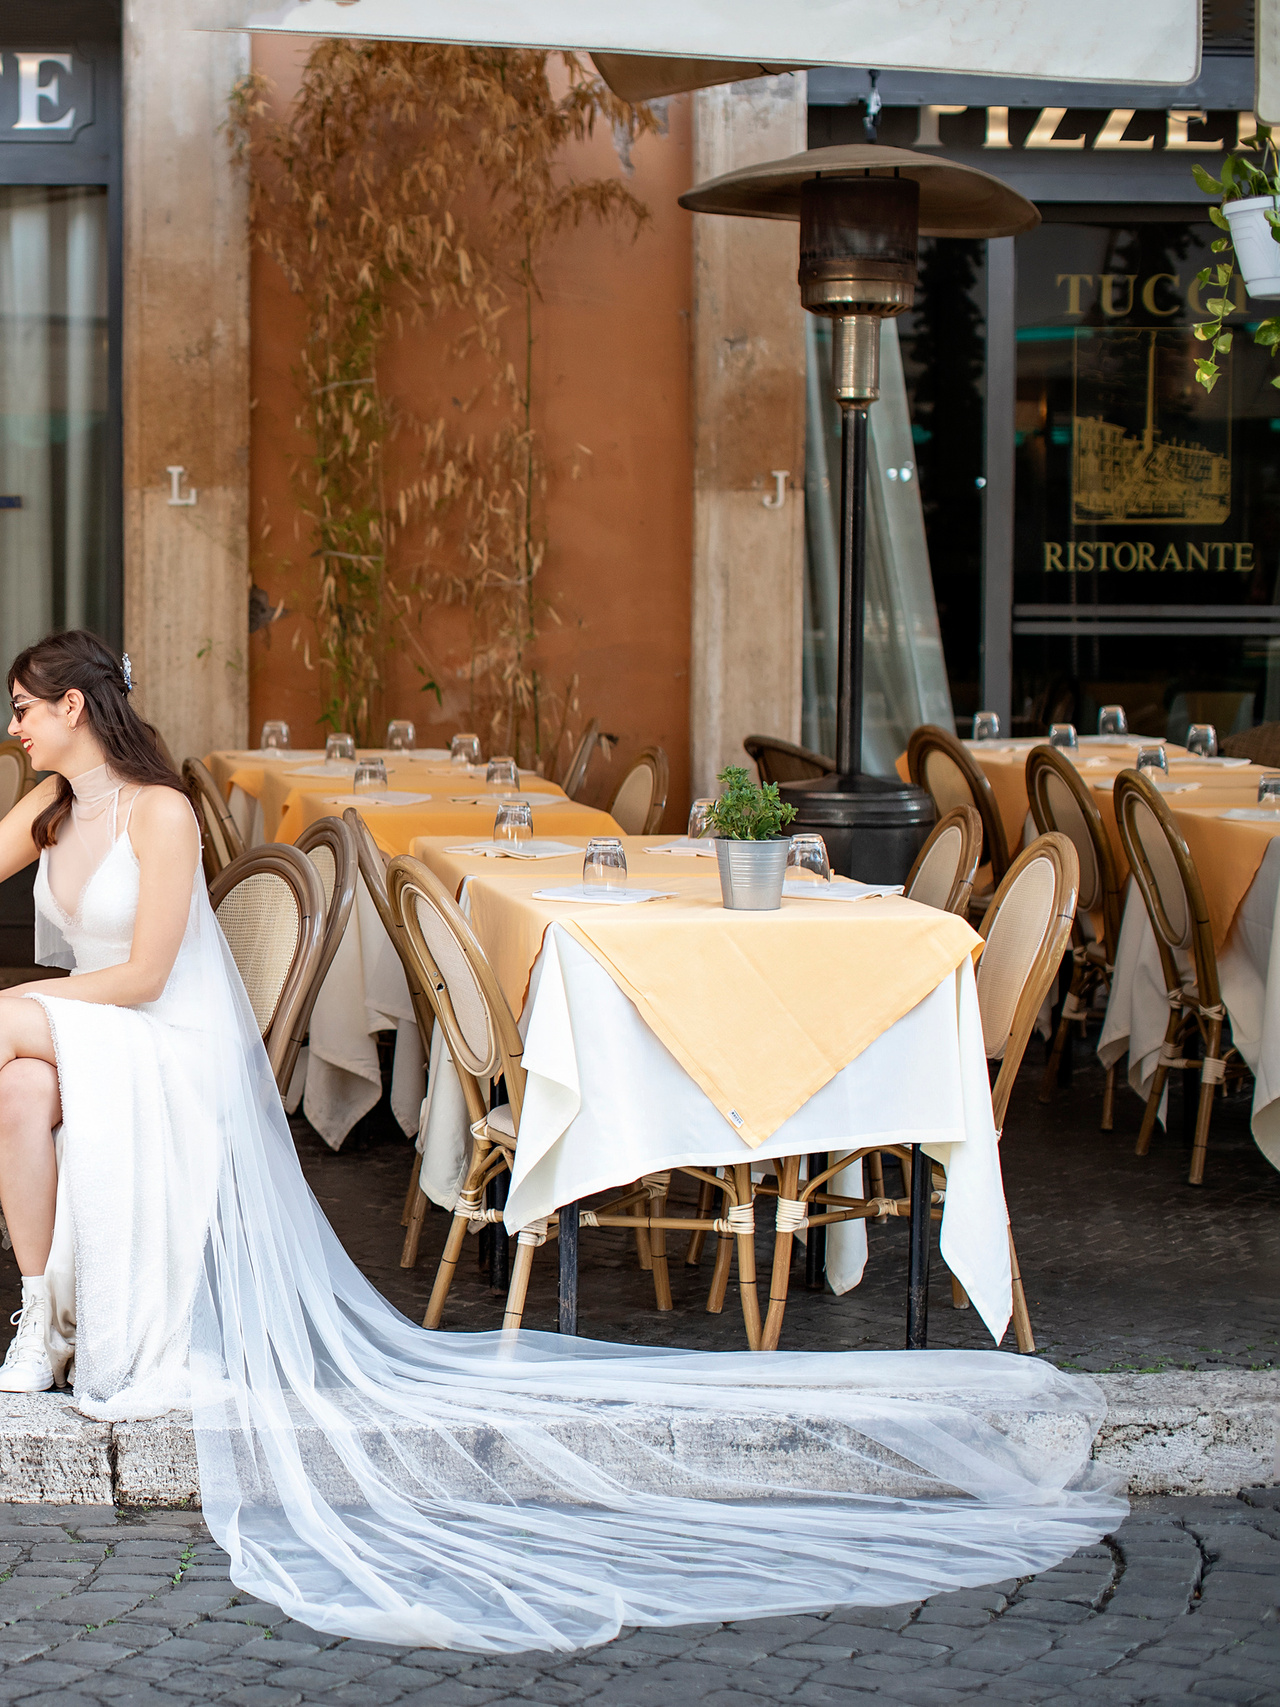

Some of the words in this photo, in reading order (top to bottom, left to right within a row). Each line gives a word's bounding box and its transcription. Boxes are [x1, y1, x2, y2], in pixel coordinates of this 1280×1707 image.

[913, 104, 1280, 150] PIZZE
[166, 465, 197, 506] L
[762, 469, 790, 510] J
[1043, 541, 1256, 573] RISTORANTE
